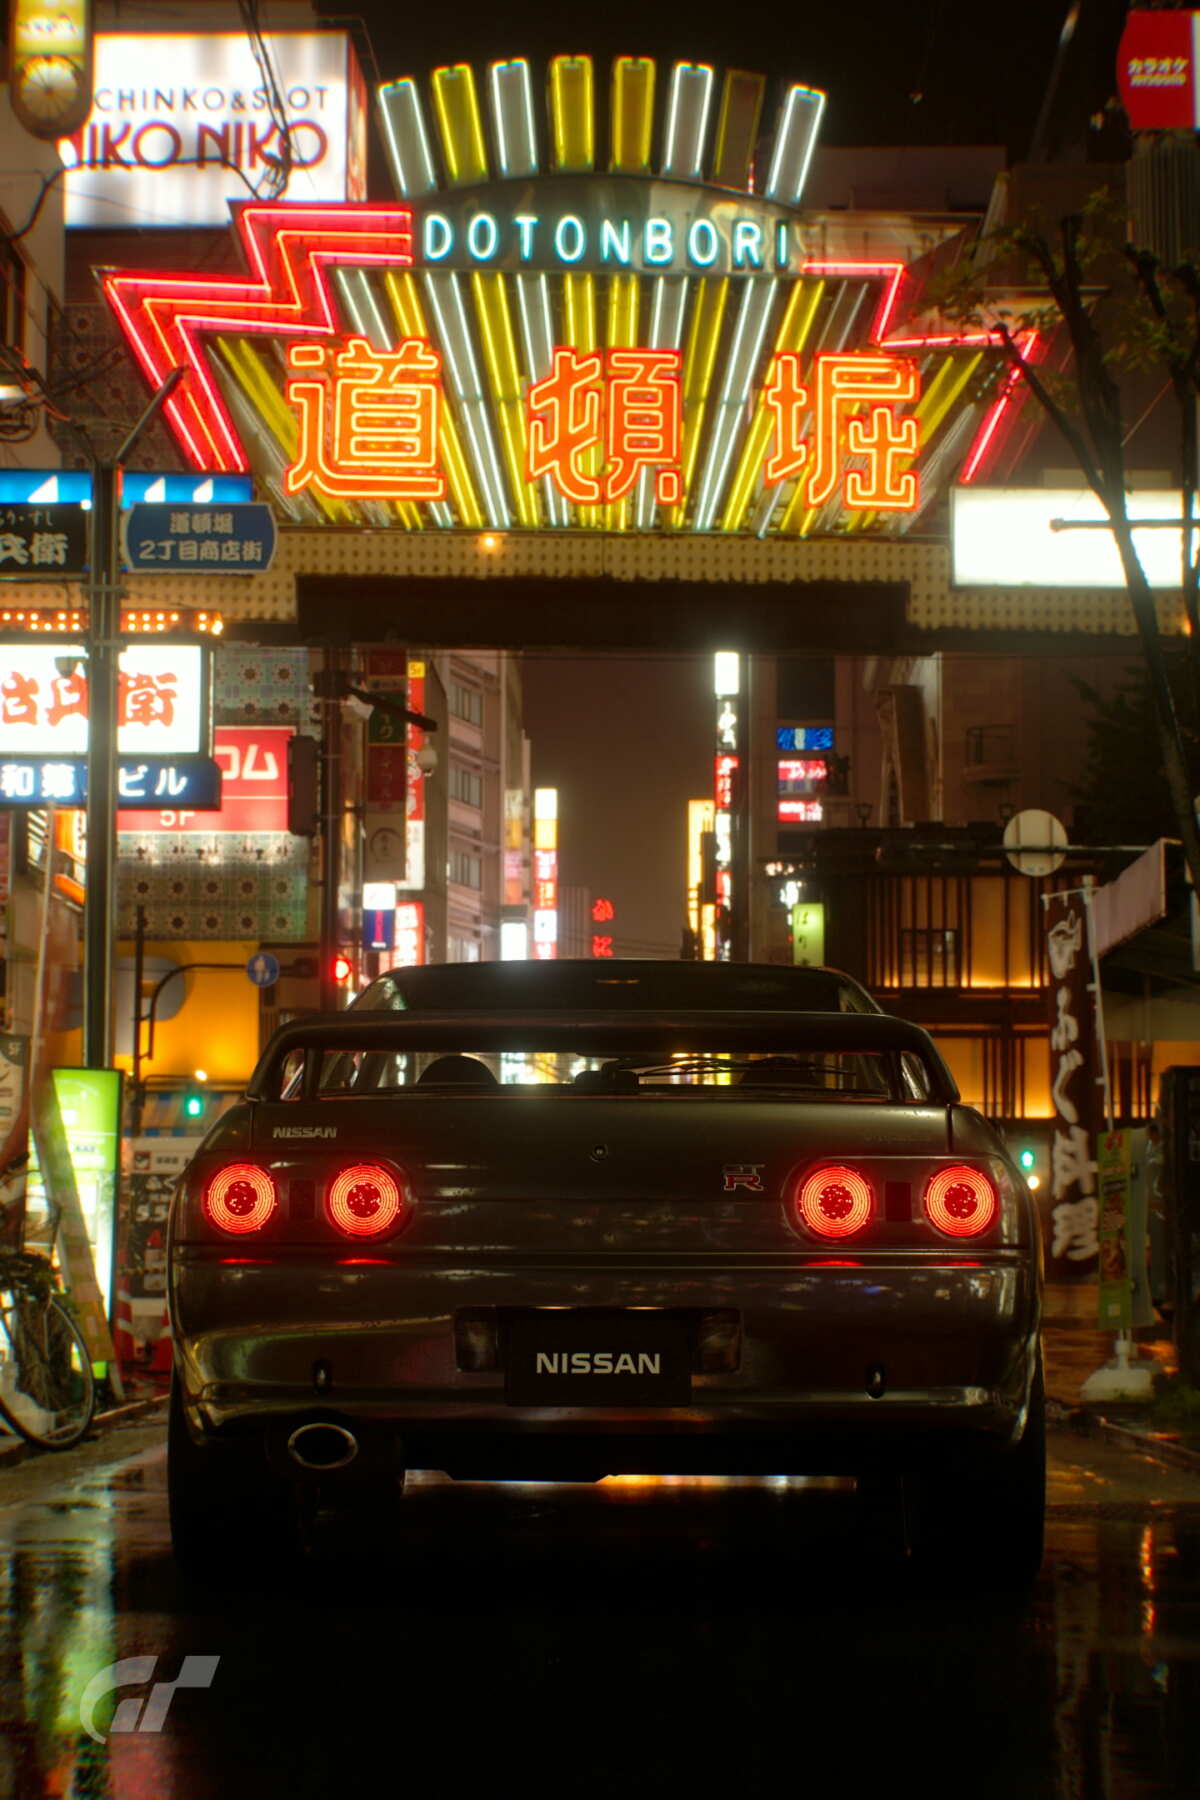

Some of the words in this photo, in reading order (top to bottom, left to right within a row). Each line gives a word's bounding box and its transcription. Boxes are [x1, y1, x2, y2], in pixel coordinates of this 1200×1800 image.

[196, 119, 328, 170] NIKO
[423, 212, 792, 268] DOTONBORI
[283, 335, 921, 511] 道頓堀
[169, 511, 234, 534] 道頓堀
[139, 539, 263, 562] 2丁目商店街
[272, 1127, 338, 1139] NISSAN
[535, 1352, 661, 1375] NISSAN
